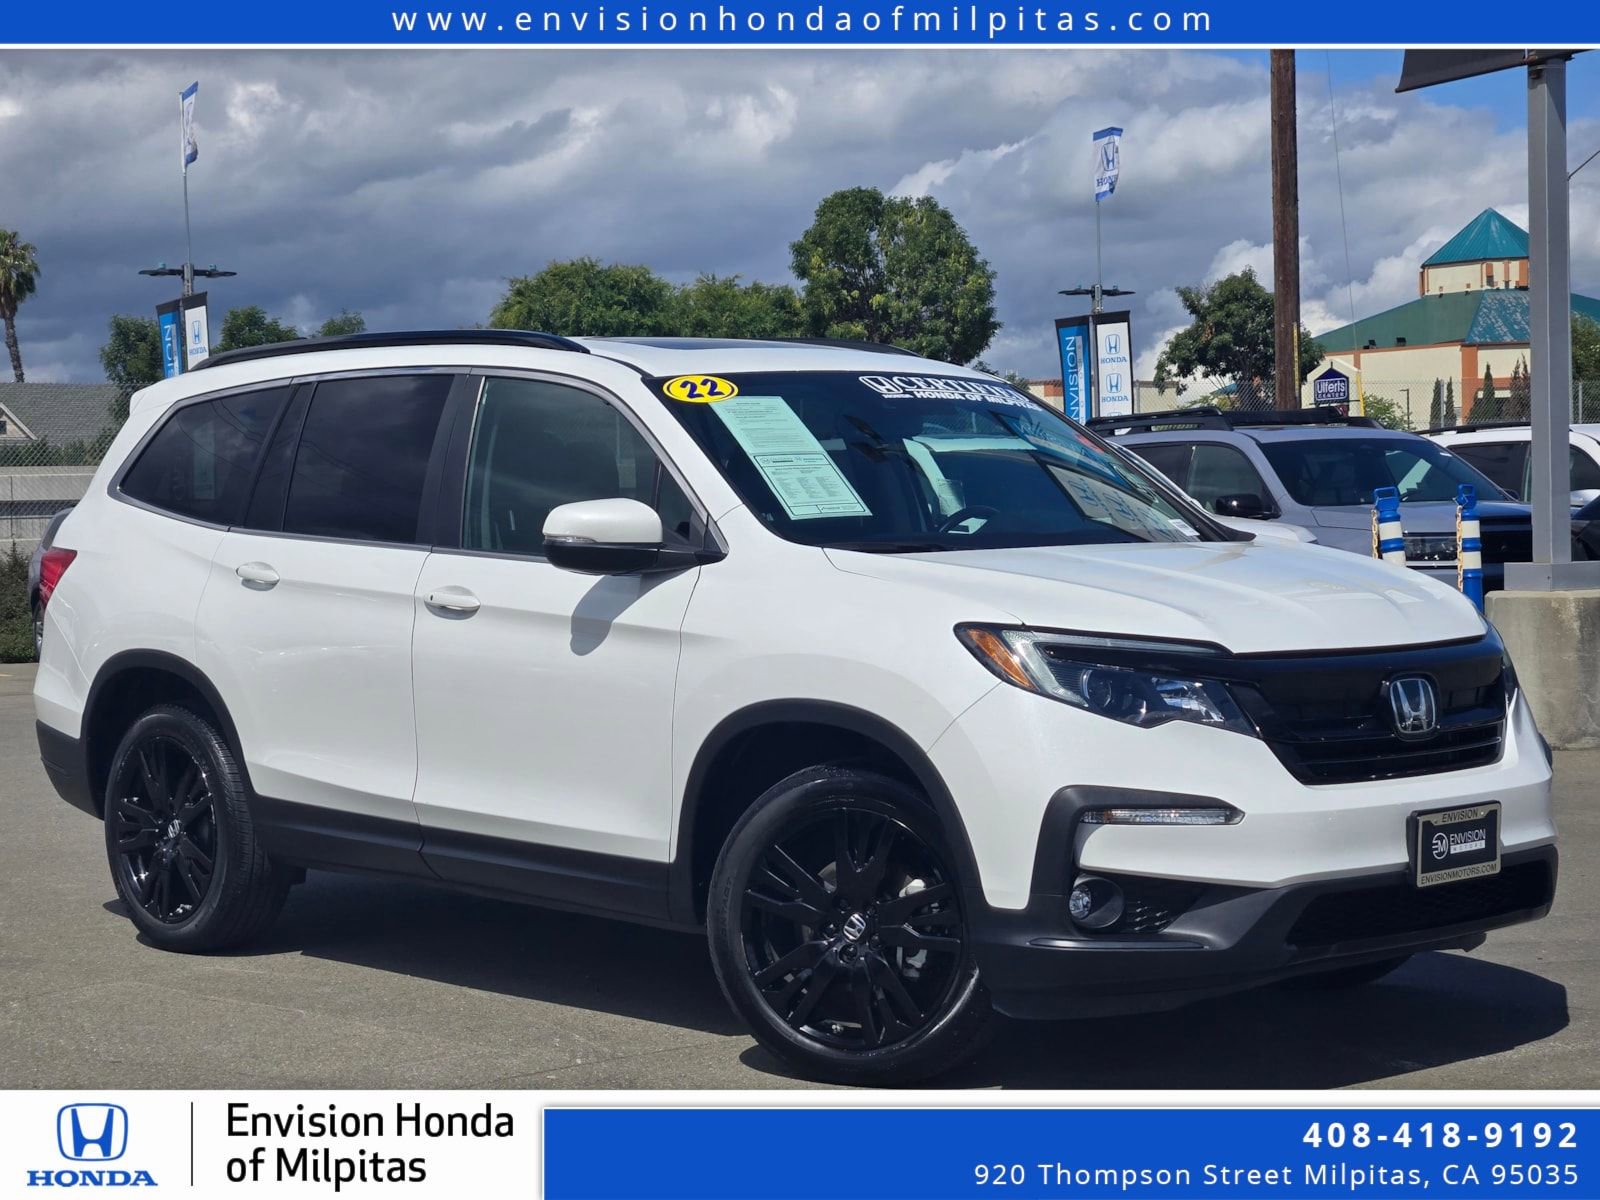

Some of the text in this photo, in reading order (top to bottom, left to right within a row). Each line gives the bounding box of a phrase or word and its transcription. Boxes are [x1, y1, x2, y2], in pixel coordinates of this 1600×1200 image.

[1100, 356, 1127, 364] HONDA
[680, 378, 726, 399] 22
[1317, 380, 1345, 393] Ulferts
[913, 391, 964, 400] HONDA
[965, 393, 983, 402] OF
[1101, 395, 1129, 403] HONDA
[1442, 808, 1478, 823] ENVISION
[1450, 828, 1486, 845] ENVISION
[1421, 863, 1497, 885] ENVISIONMOTORS.COM
